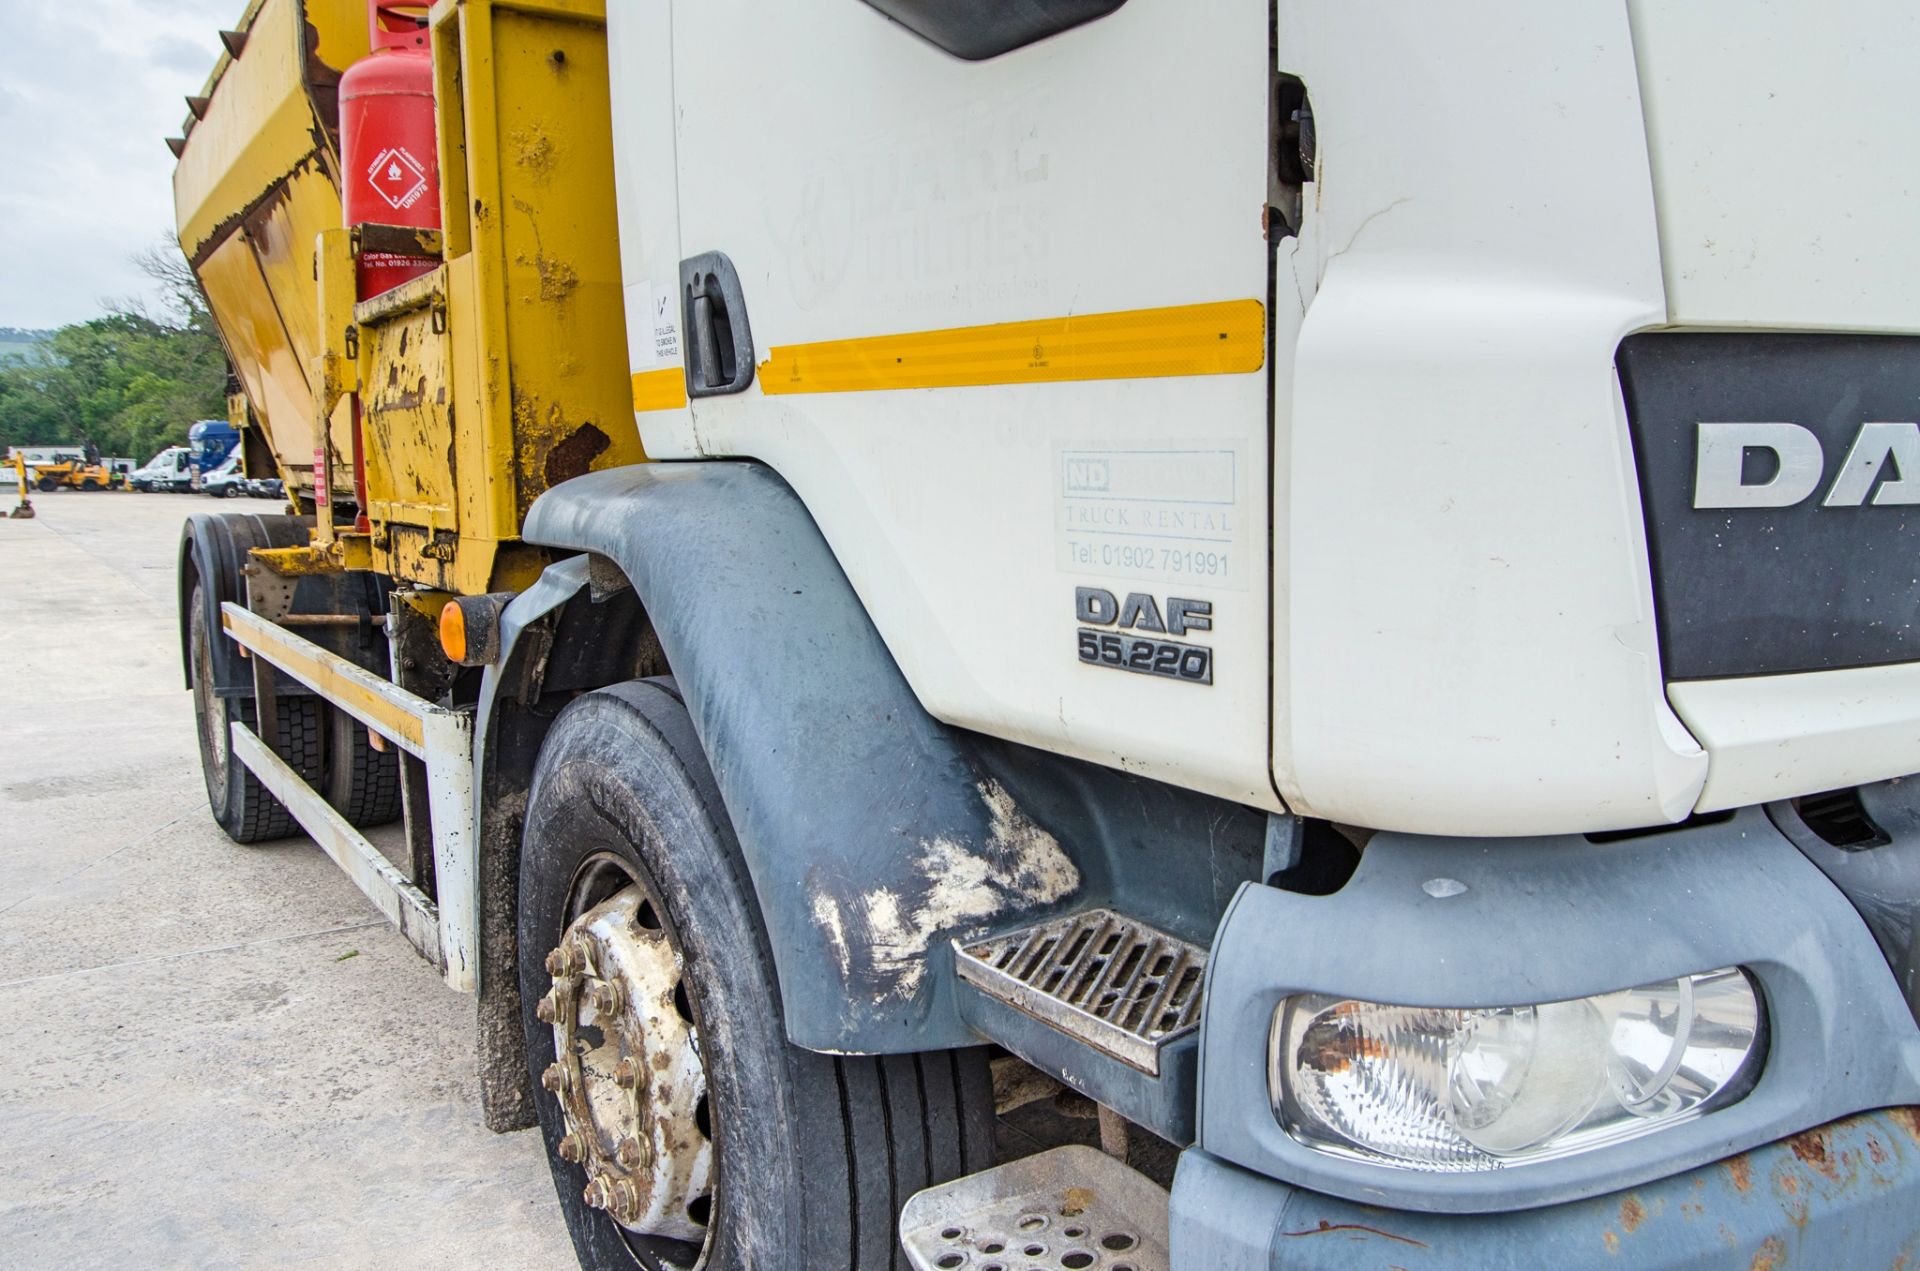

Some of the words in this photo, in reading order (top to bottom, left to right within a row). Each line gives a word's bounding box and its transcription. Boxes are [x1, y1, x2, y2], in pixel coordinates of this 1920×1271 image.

[1066, 506, 1129, 526] TRUCK
[1143, 510, 1232, 531] RENTAL
[1068, 541, 1097, 564] Tel:
[1102, 544, 1155, 570] 01902
[1160, 549, 1229, 576] 791991
[1075, 586, 1212, 636] DAF
[1078, 632, 1208, 680] 55.220
